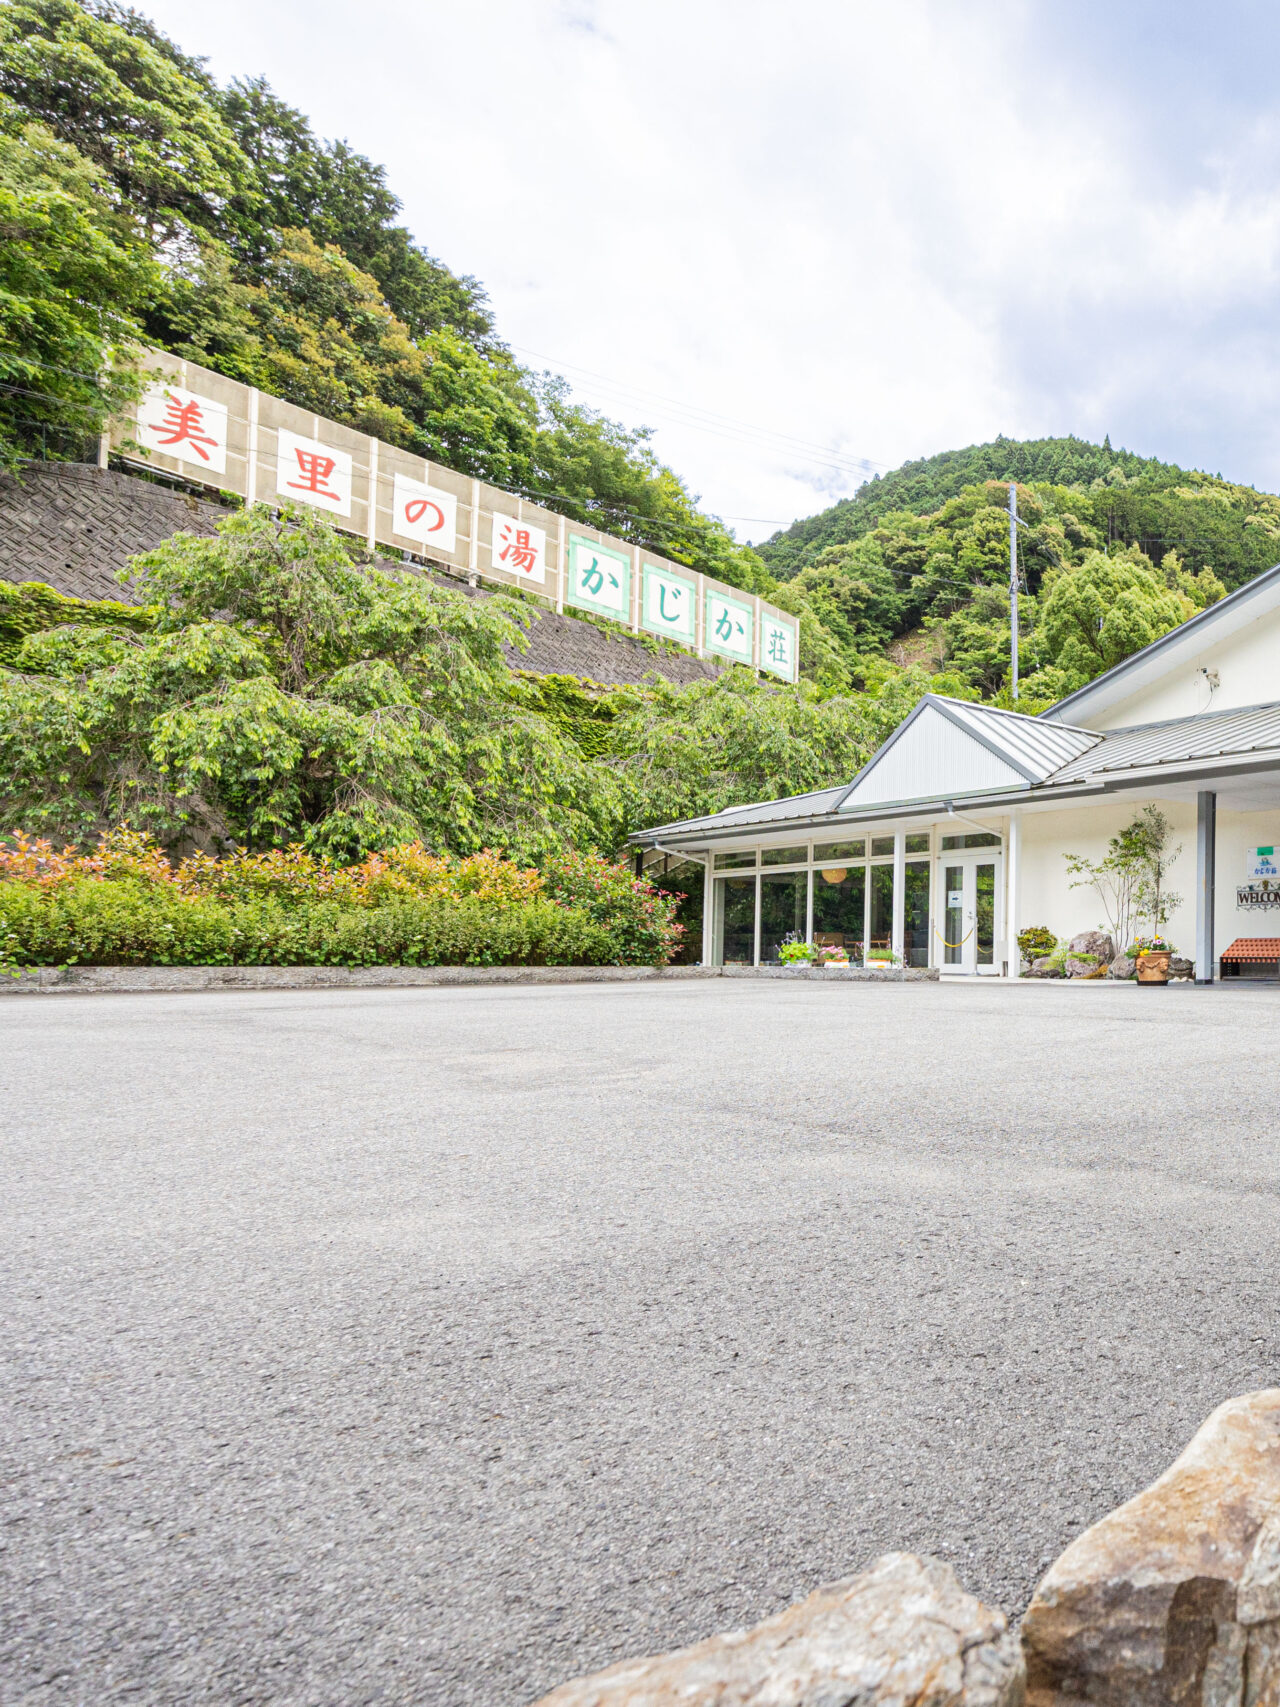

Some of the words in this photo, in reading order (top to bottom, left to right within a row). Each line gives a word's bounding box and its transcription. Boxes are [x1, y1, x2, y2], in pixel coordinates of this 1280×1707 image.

[148, 393, 538, 574] 美里の湯
[581, 556, 789, 665] かじか荘
